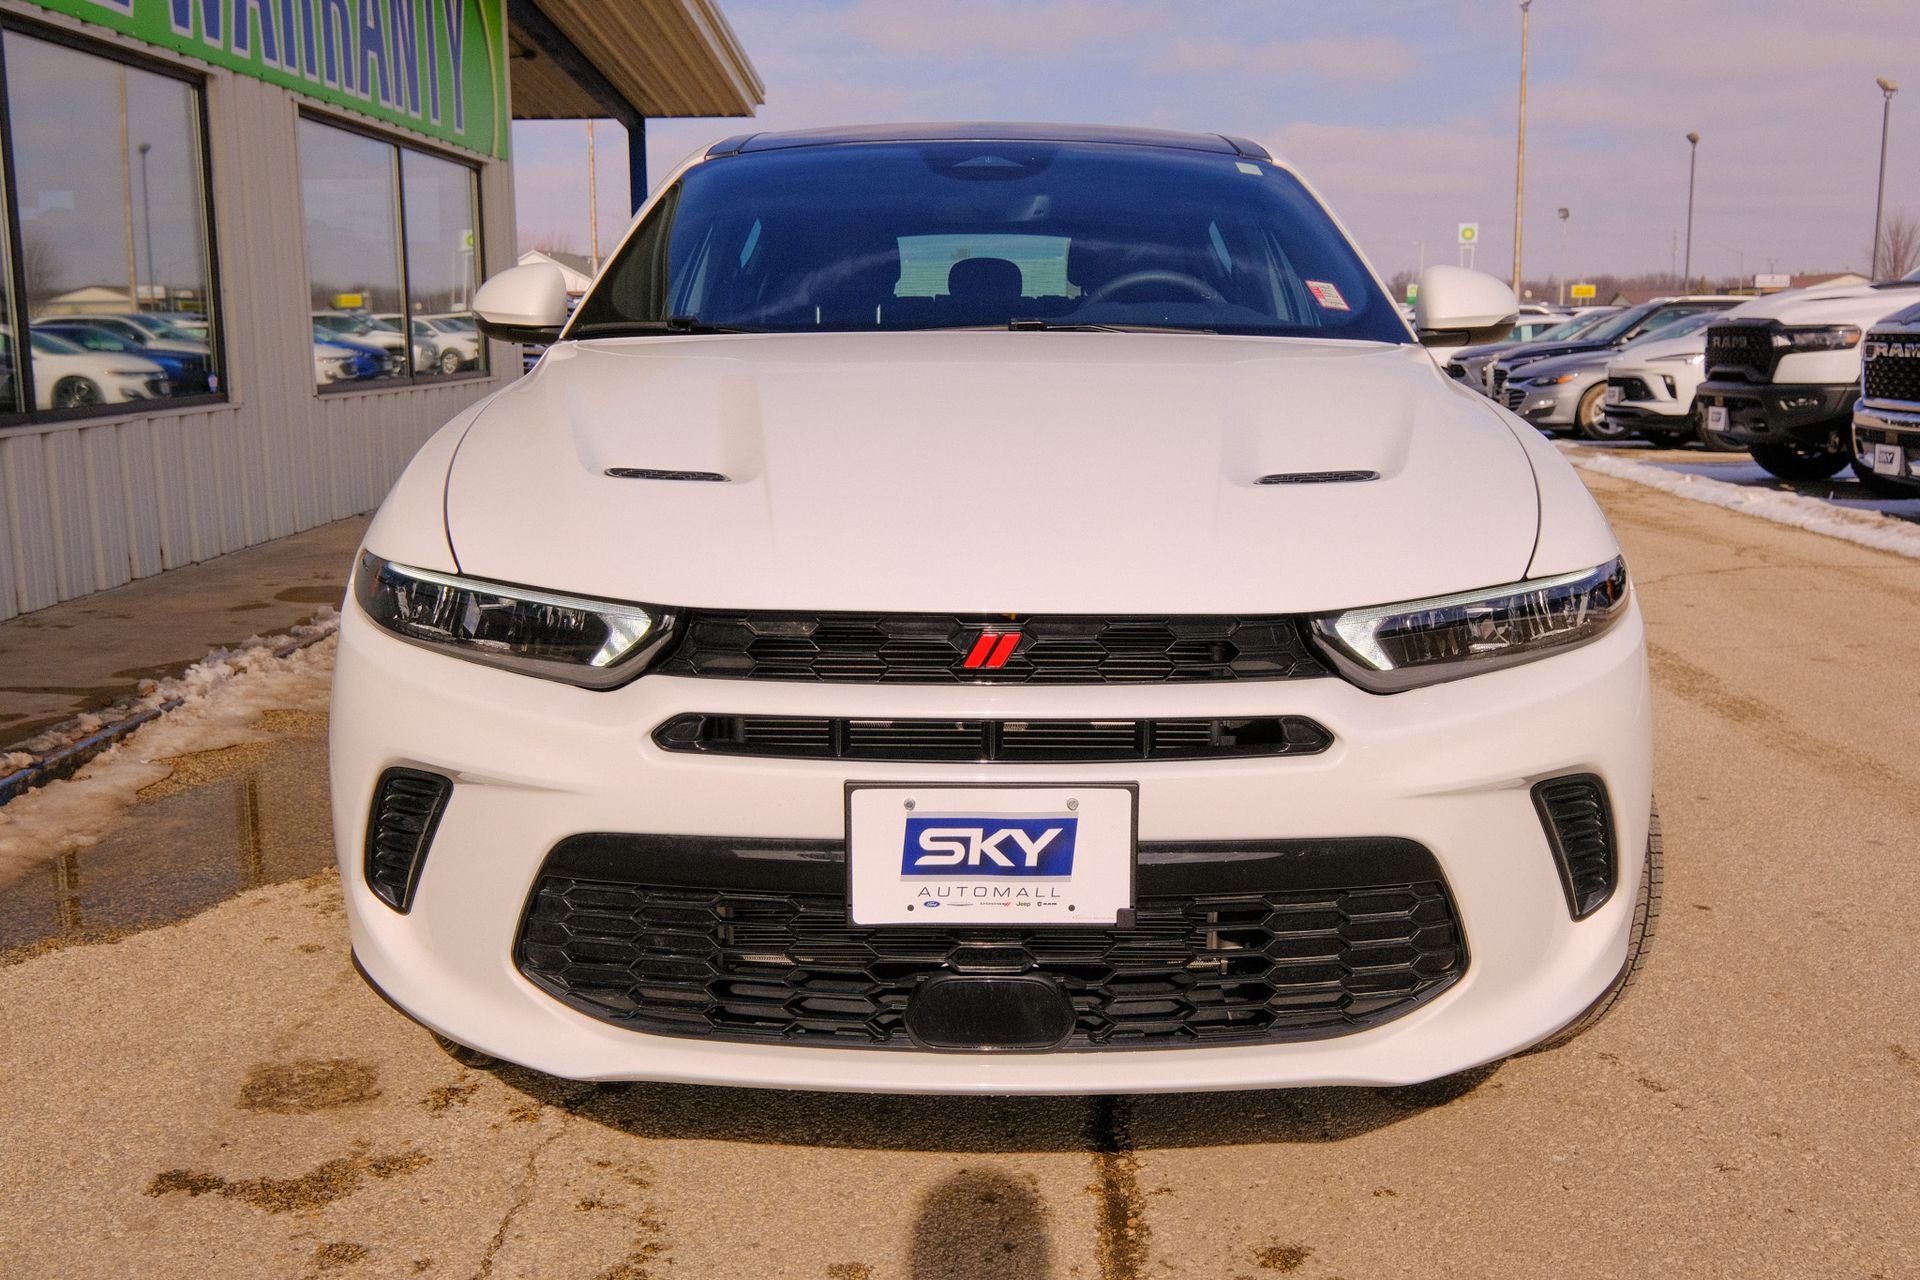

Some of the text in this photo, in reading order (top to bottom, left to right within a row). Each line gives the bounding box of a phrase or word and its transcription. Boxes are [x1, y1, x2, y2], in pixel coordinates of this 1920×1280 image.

[168, 0, 465, 135] RANTY
[1712, 336, 1748, 349] RAM
[1875, 342, 1920, 358] RAM
[914, 827, 1064, 867] SKY
[917, 886, 1061, 898] AUTOMALL
